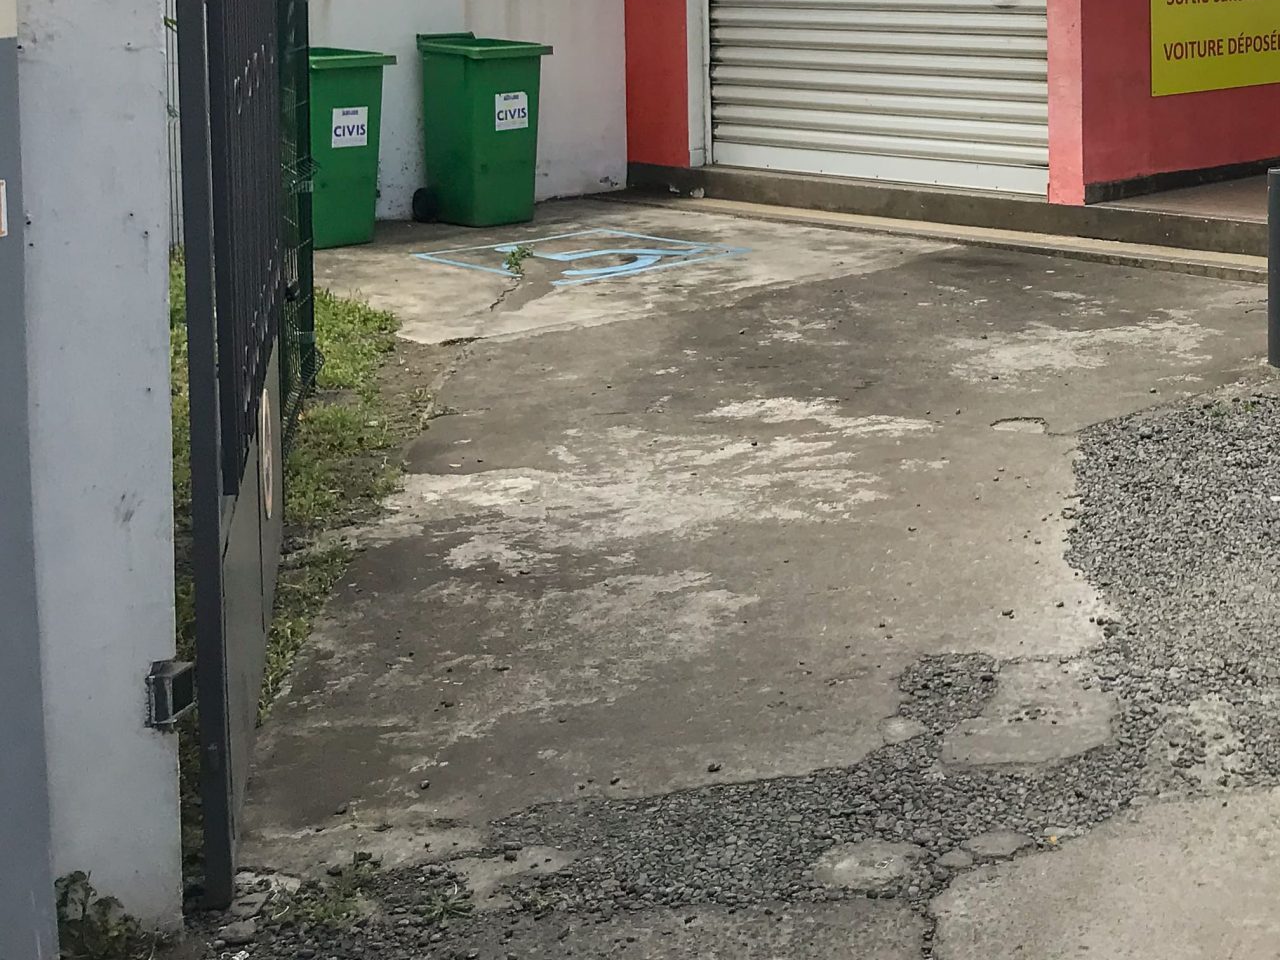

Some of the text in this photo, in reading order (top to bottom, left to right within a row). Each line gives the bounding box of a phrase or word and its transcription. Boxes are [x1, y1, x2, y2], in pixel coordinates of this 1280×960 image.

[1164, 38, 1224, 61] VOITURE
[497, 107, 527, 121] CIVIS
[333, 124, 366, 137] CIVIS
